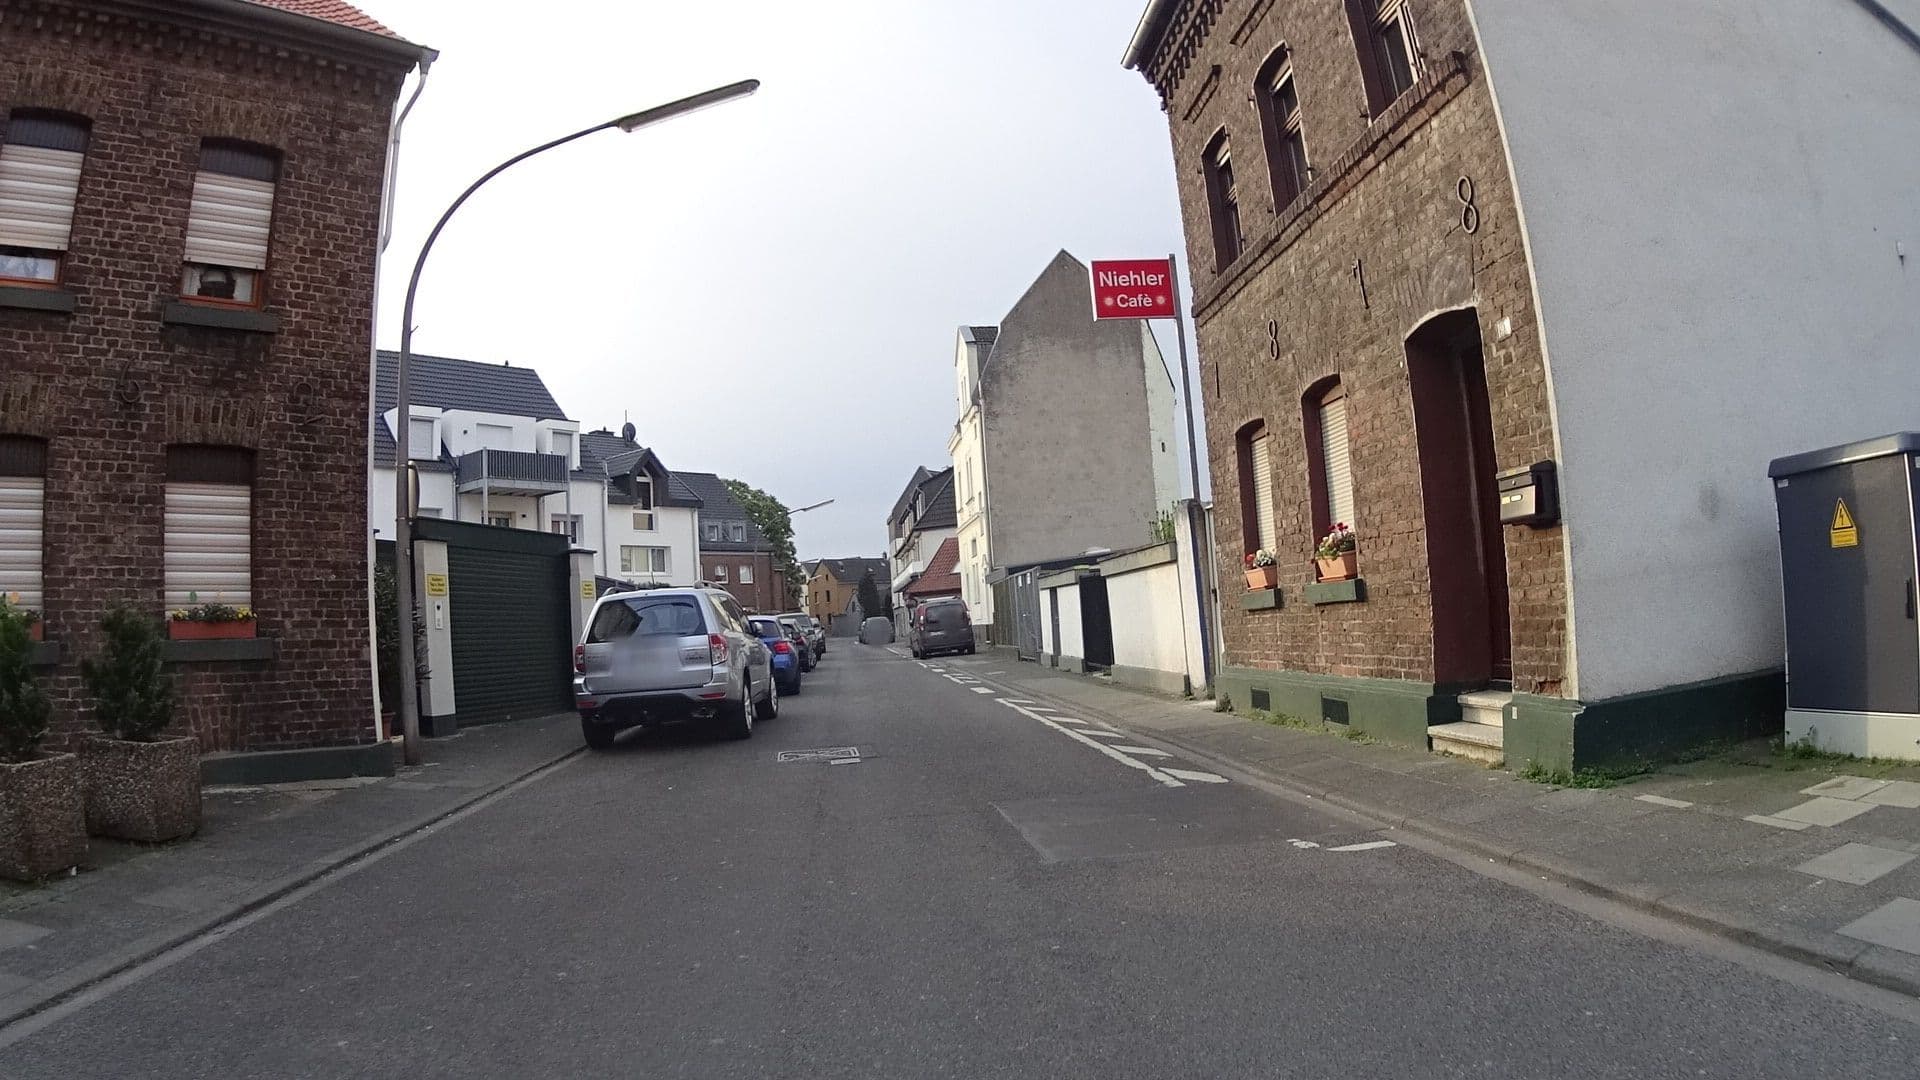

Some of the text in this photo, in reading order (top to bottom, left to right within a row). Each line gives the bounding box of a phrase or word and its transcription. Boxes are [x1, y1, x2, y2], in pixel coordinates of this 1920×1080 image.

[1099, 270, 1165, 287] Niehler
[1267, 318, 1279, 361] 8
[1456, 175, 1478, 234] 8
